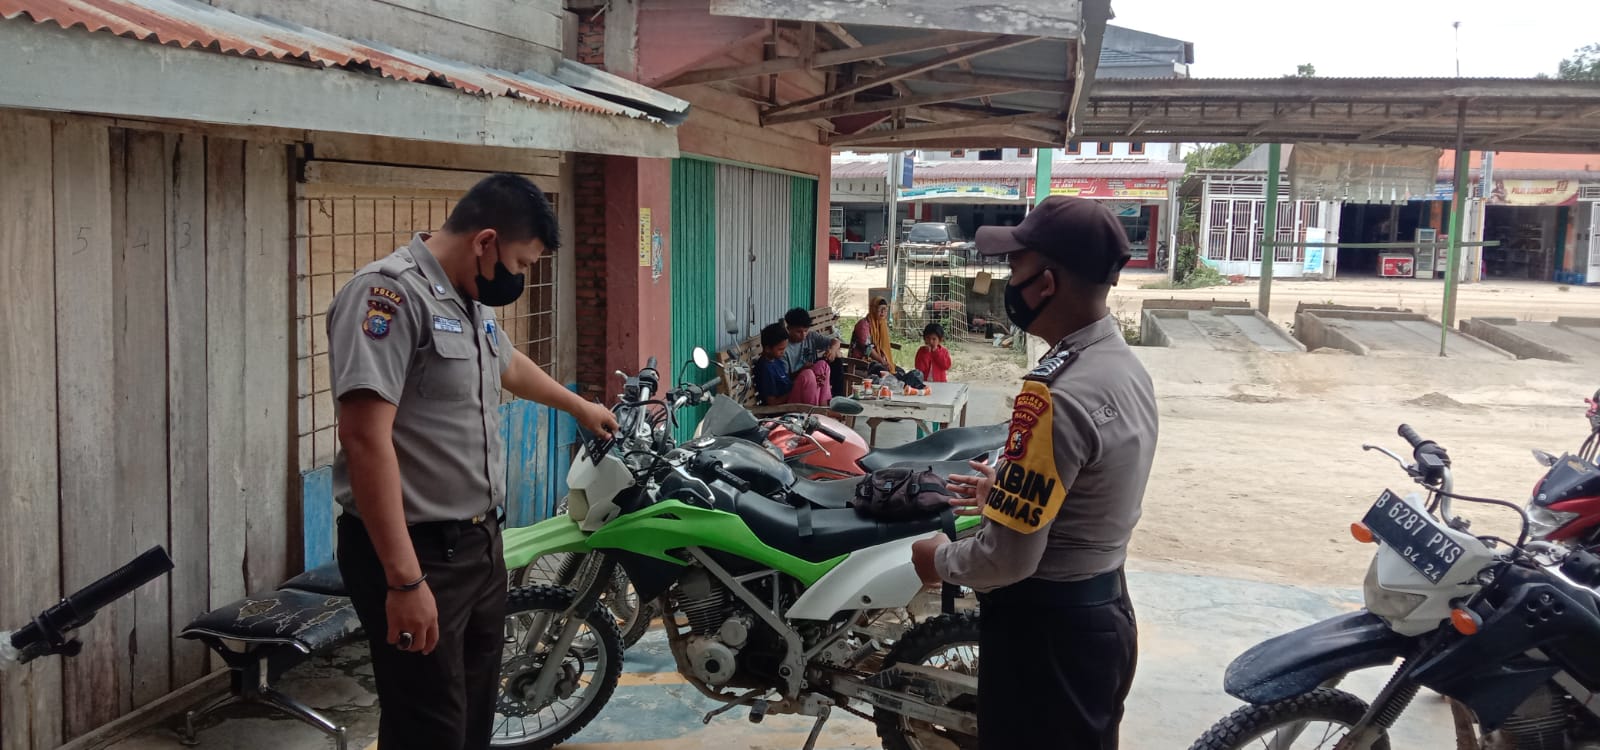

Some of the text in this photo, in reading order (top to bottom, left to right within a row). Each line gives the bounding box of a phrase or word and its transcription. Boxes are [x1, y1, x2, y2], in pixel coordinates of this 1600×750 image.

[72, 227, 91, 255] 5
[132, 226, 150, 253] 4
[180, 222, 192, 249] 3
[373, 287, 401, 303] POLDA
[1376, 492, 1460, 564] B 6287 PXS
[1403, 546, 1441, 580] 04 24
